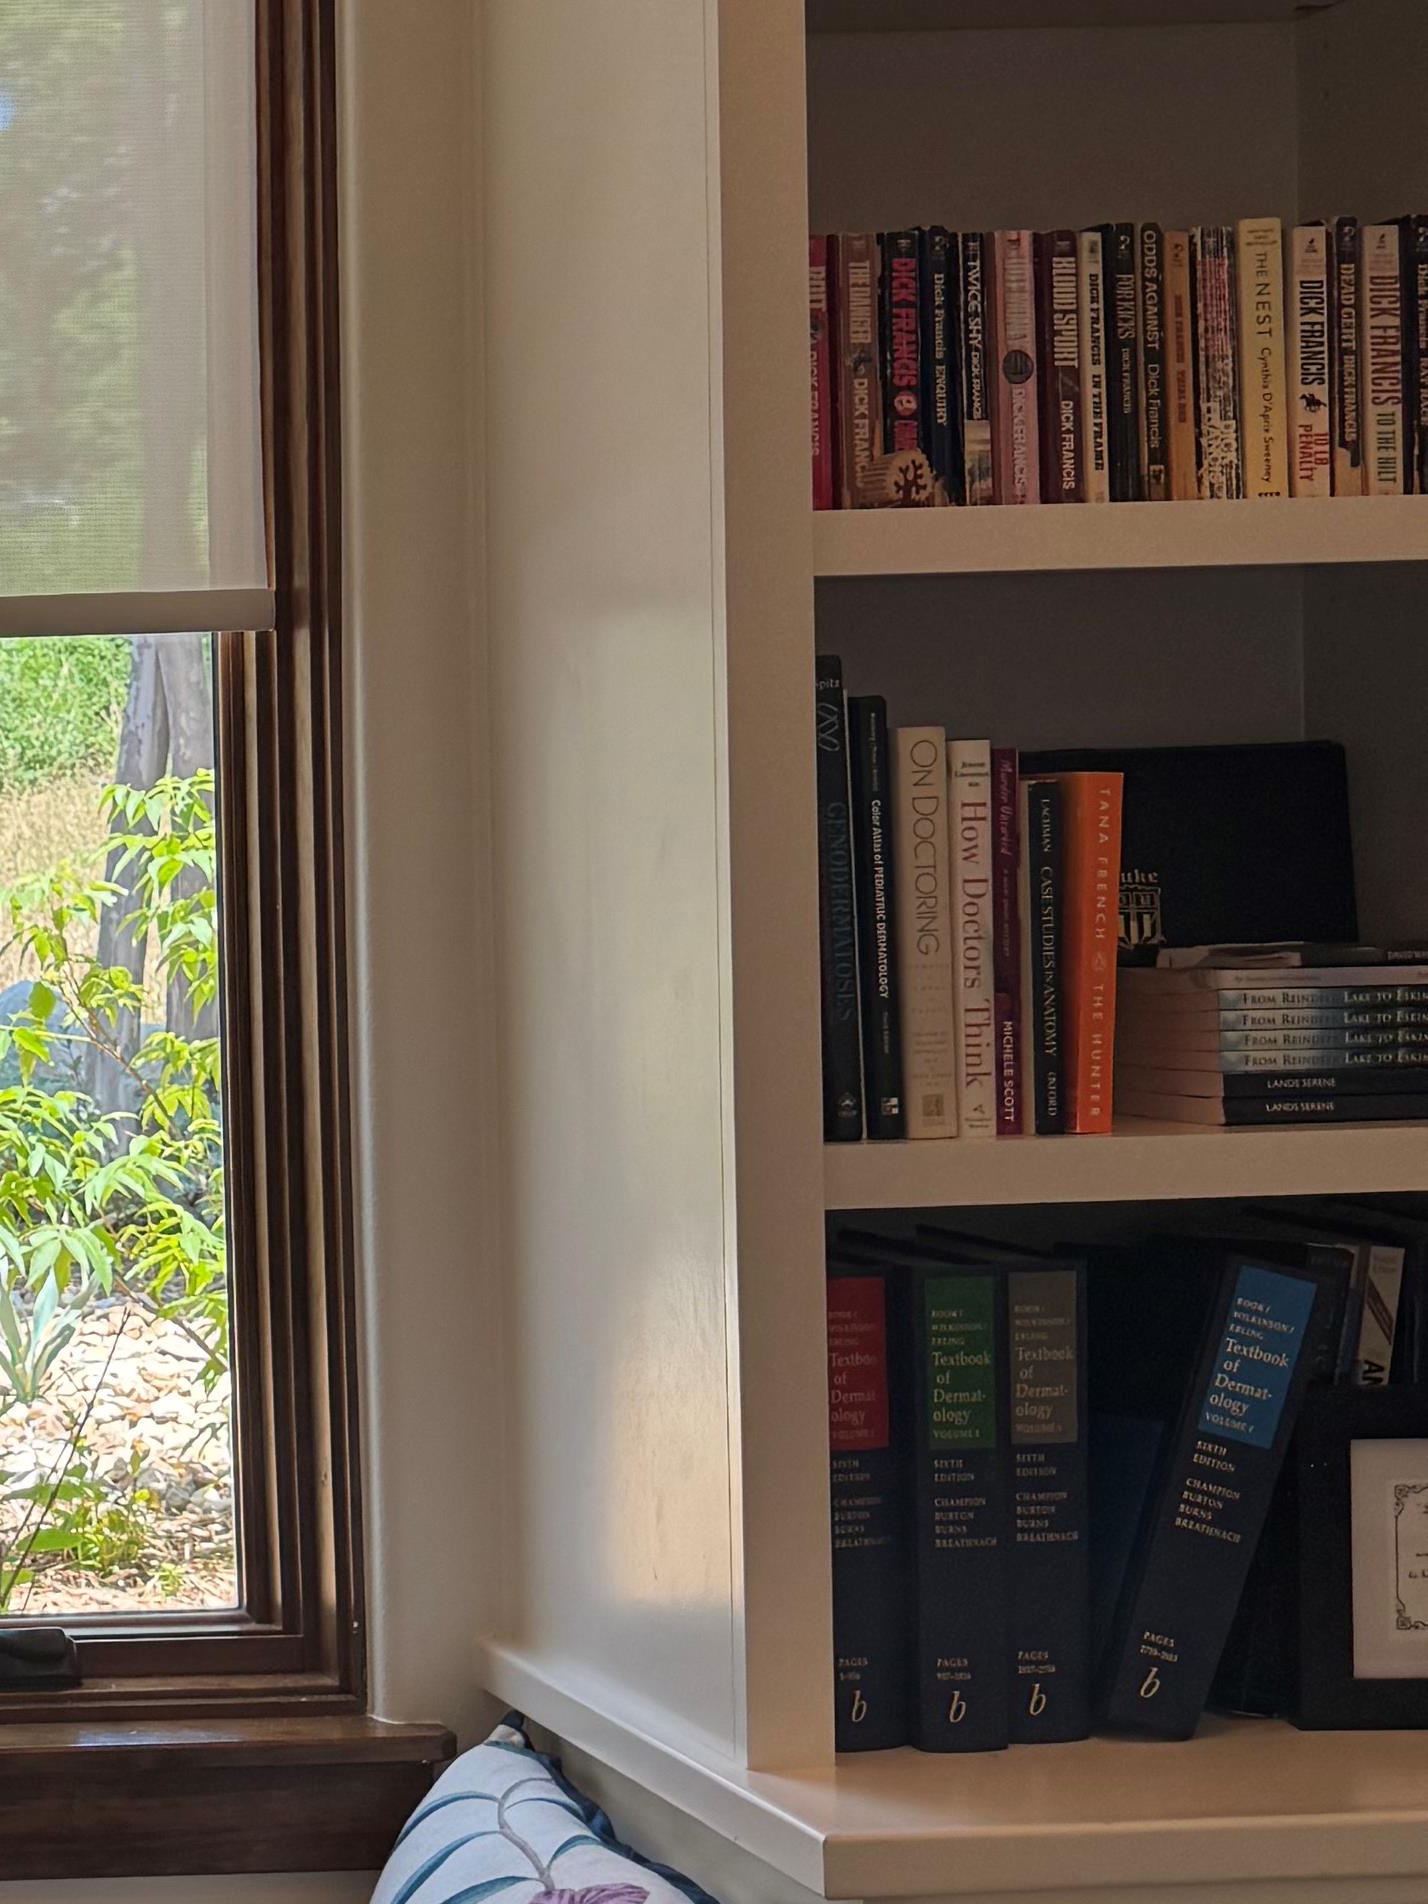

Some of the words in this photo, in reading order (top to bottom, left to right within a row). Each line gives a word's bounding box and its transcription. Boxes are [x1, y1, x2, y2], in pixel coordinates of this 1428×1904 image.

[1143, 231, 1157, 277] ODDS
[1256, 253, 1269, 276] THE
[891, 258, 917, 302] DICK
[934, 273, 945, 305] Dick
[968, 259, 981, 313] TWICE
[1052, 257, 1077, 310] BLOOD
[1089, 274, 1099, 305] DICK
[1116, 274, 1134, 299] FOR
[1300, 280, 1324, 316] DICK
[1340, 264, 1355, 304] DEAD
[1369, 276, 1399, 317] DICK
[1117, 300, 1135, 339] KICKS
[1146, 281, 1160, 350] AGAINST
[1256, 283, 1272, 337] NEST
[892, 307, 918, 387] FRANCIS
[935, 309, 946, 358] Francis
[969, 318, 982, 347] SHY
[1054, 313, 1078, 368] SPORT
[1090, 308, 1101, 365] FRANCIS
[1300, 322, 1325, 385] FRANCIS
[1370, 326, 1401, 405] FRANCIS
[853, 378, 869, 416] DICK
[935, 365, 947, 425] ENQUIRY
[1092, 374, 1102, 388] IN
[1147, 364, 1160, 396] Dick
[1061, 401, 1074, 431] DICK
[1148, 400, 1161, 448] Francis
[1376, 412, 1395, 426] TO
[1062, 434, 1075, 489] FRANCIS
[1261, 437, 1273, 483] Sweeney
[1298, 424, 1316, 481] PENALTY
[1377, 431, 1396, 451] THE
[1377, 457, 1397, 483] HILT
[910, 740, 939, 786] ON
[871, 800, 883, 826] Color
[959, 801, 988, 863] How
[1098, 788, 1111, 843] TANA
[872, 828, 885, 852] Atlas
[873, 854, 885, 865] of
[874, 867, 887, 920] PEDIATRIC
[911, 797, 941, 955] DOCTORING
[1040, 866, 1054, 903] CASE
[1120, 868, 1158, 883] uke
[1095, 857, 1108, 940] FRENCH
[962, 878, 990, 989] Doctors
[1040, 906, 1055, 968] STUDIES
[876, 923, 889, 998] DERMATOLOGY
[1042, 983, 1057, 1056] ANATOMY
[1091, 984, 1104, 1020] THE
[963, 999, 992, 1088] Think
[1001, 1021, 1015, 1075] MICHELE
[1090, 1034, 1104, 1116] HUNTER
[1267, 1078, 1298, 1088] LANDS
[1003, 1080, 1016, 1122] SCOTT
[1266, 1102, 1298, 1112] LANDS
[932, 1350, 992, 1366] Textbook
[1020, 1366, 1033, 1380] of
[1223, 1359, 1240, 1374] of
[1225, 1337, 1289, 1368] Textbook
[936, 1371, 952, 1384] of
[933, 1408, 971, 1425] ology
[1016, 1403, 1054, 1420] ology
[1209, 1393, 1250, 1416] ology
